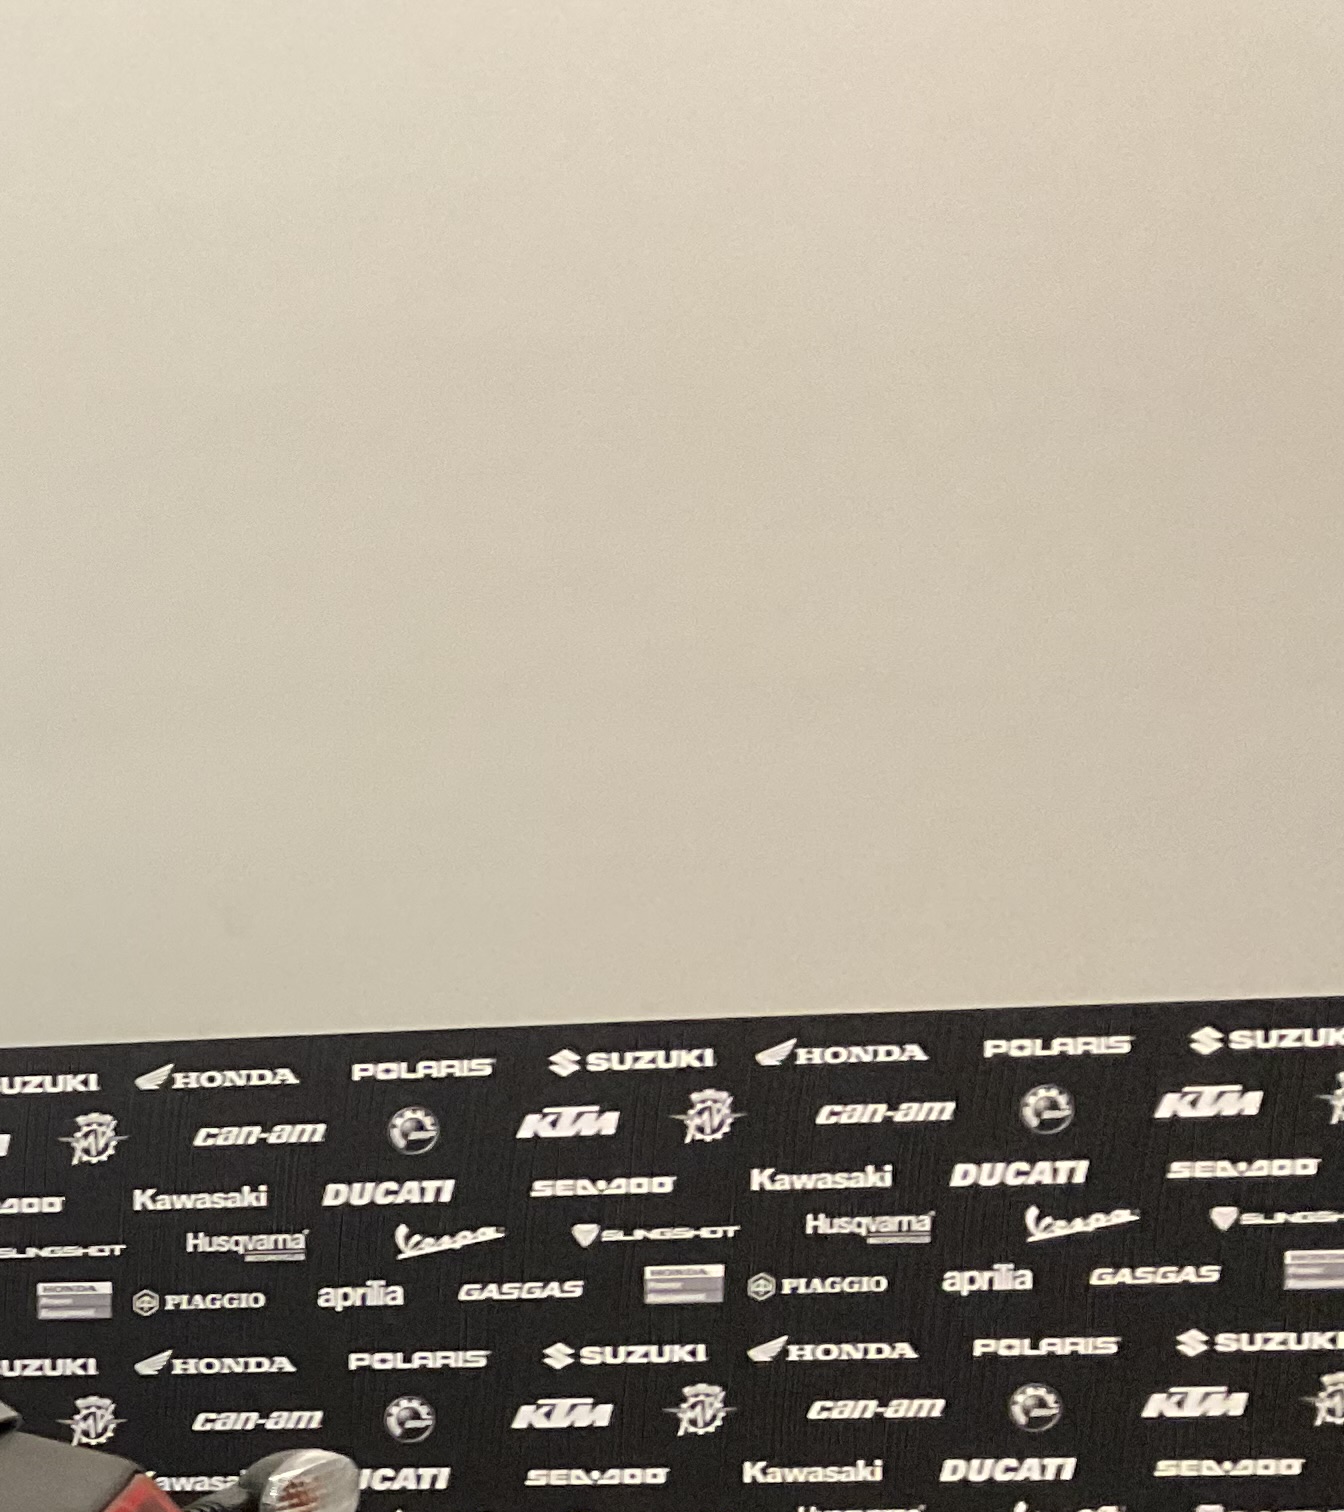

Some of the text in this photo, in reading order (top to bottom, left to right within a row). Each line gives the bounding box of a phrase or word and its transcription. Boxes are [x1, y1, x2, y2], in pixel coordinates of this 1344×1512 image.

[984, 1036, 1134, 1057] POLARIS
[1229, 1028, 1344, 1049] SUZUK
[586, 1048, 714, 1071] SUZUKI
[795, 1044, 929, 1064] HONDA
[172, 1068, 299, 1088] HONDA
[352, 1058, 496, 1080] POLARIS
[1154, 1085, 1263, 1118] KTM
[516, 1106, 620, 1138] KTM
[816, 1102, 956, 1124] can-am
[193, 1124, 326, 1146] can-am
[751, 1165, 892, 1190] Kawasaki
[950, 1160, 1089, 1186] DUCATI
[133, 1185, 267, 1210] Kawasaki
[322, 1180, 455, 1206] DUCATI
[601, 1226, 740, 1241] SLINGSHOT
[805, 1211, 932, 1237] Husqvarna
[1025, 1206, 1139, 1242] Vespa
[186, 1230, 306, 1256] Husqvarna
[395, 1224, 505, 1259] Vespa
[781, 1276, 888, 1294] PIAGGIO
[942, 1264, 1033, 1296] aprilia
[1090, 1265, 1221, 1285] GASGAS
[165, 1293, 265, 1310] PIAGGIO
[317, 1280, 404, 1311] aprilia
[458, 1281, 584, 1300] GASGAS
[580, 1344, 707, 1364] SUZUKI
[786, 1343, 918, 1360] HONDA
[973, 1337, 1121, 1356] POLARIS
[171, 1357, 296, 1374] HONDA
[349, 1351, 491, 1370] POLARIS
[807, 1399, 945, 1419] can-am
[1141, 1386, 1249, 1417] KTM
[192, 1411, 323, 1430] can-am
[511, 1398, 613, 1428] KTM
[360, 1466, 451, 1490] CATI
[743, 1460, 883, 1483] Kawasaki
[940, 1458, 1077, 1482] DUCATI
